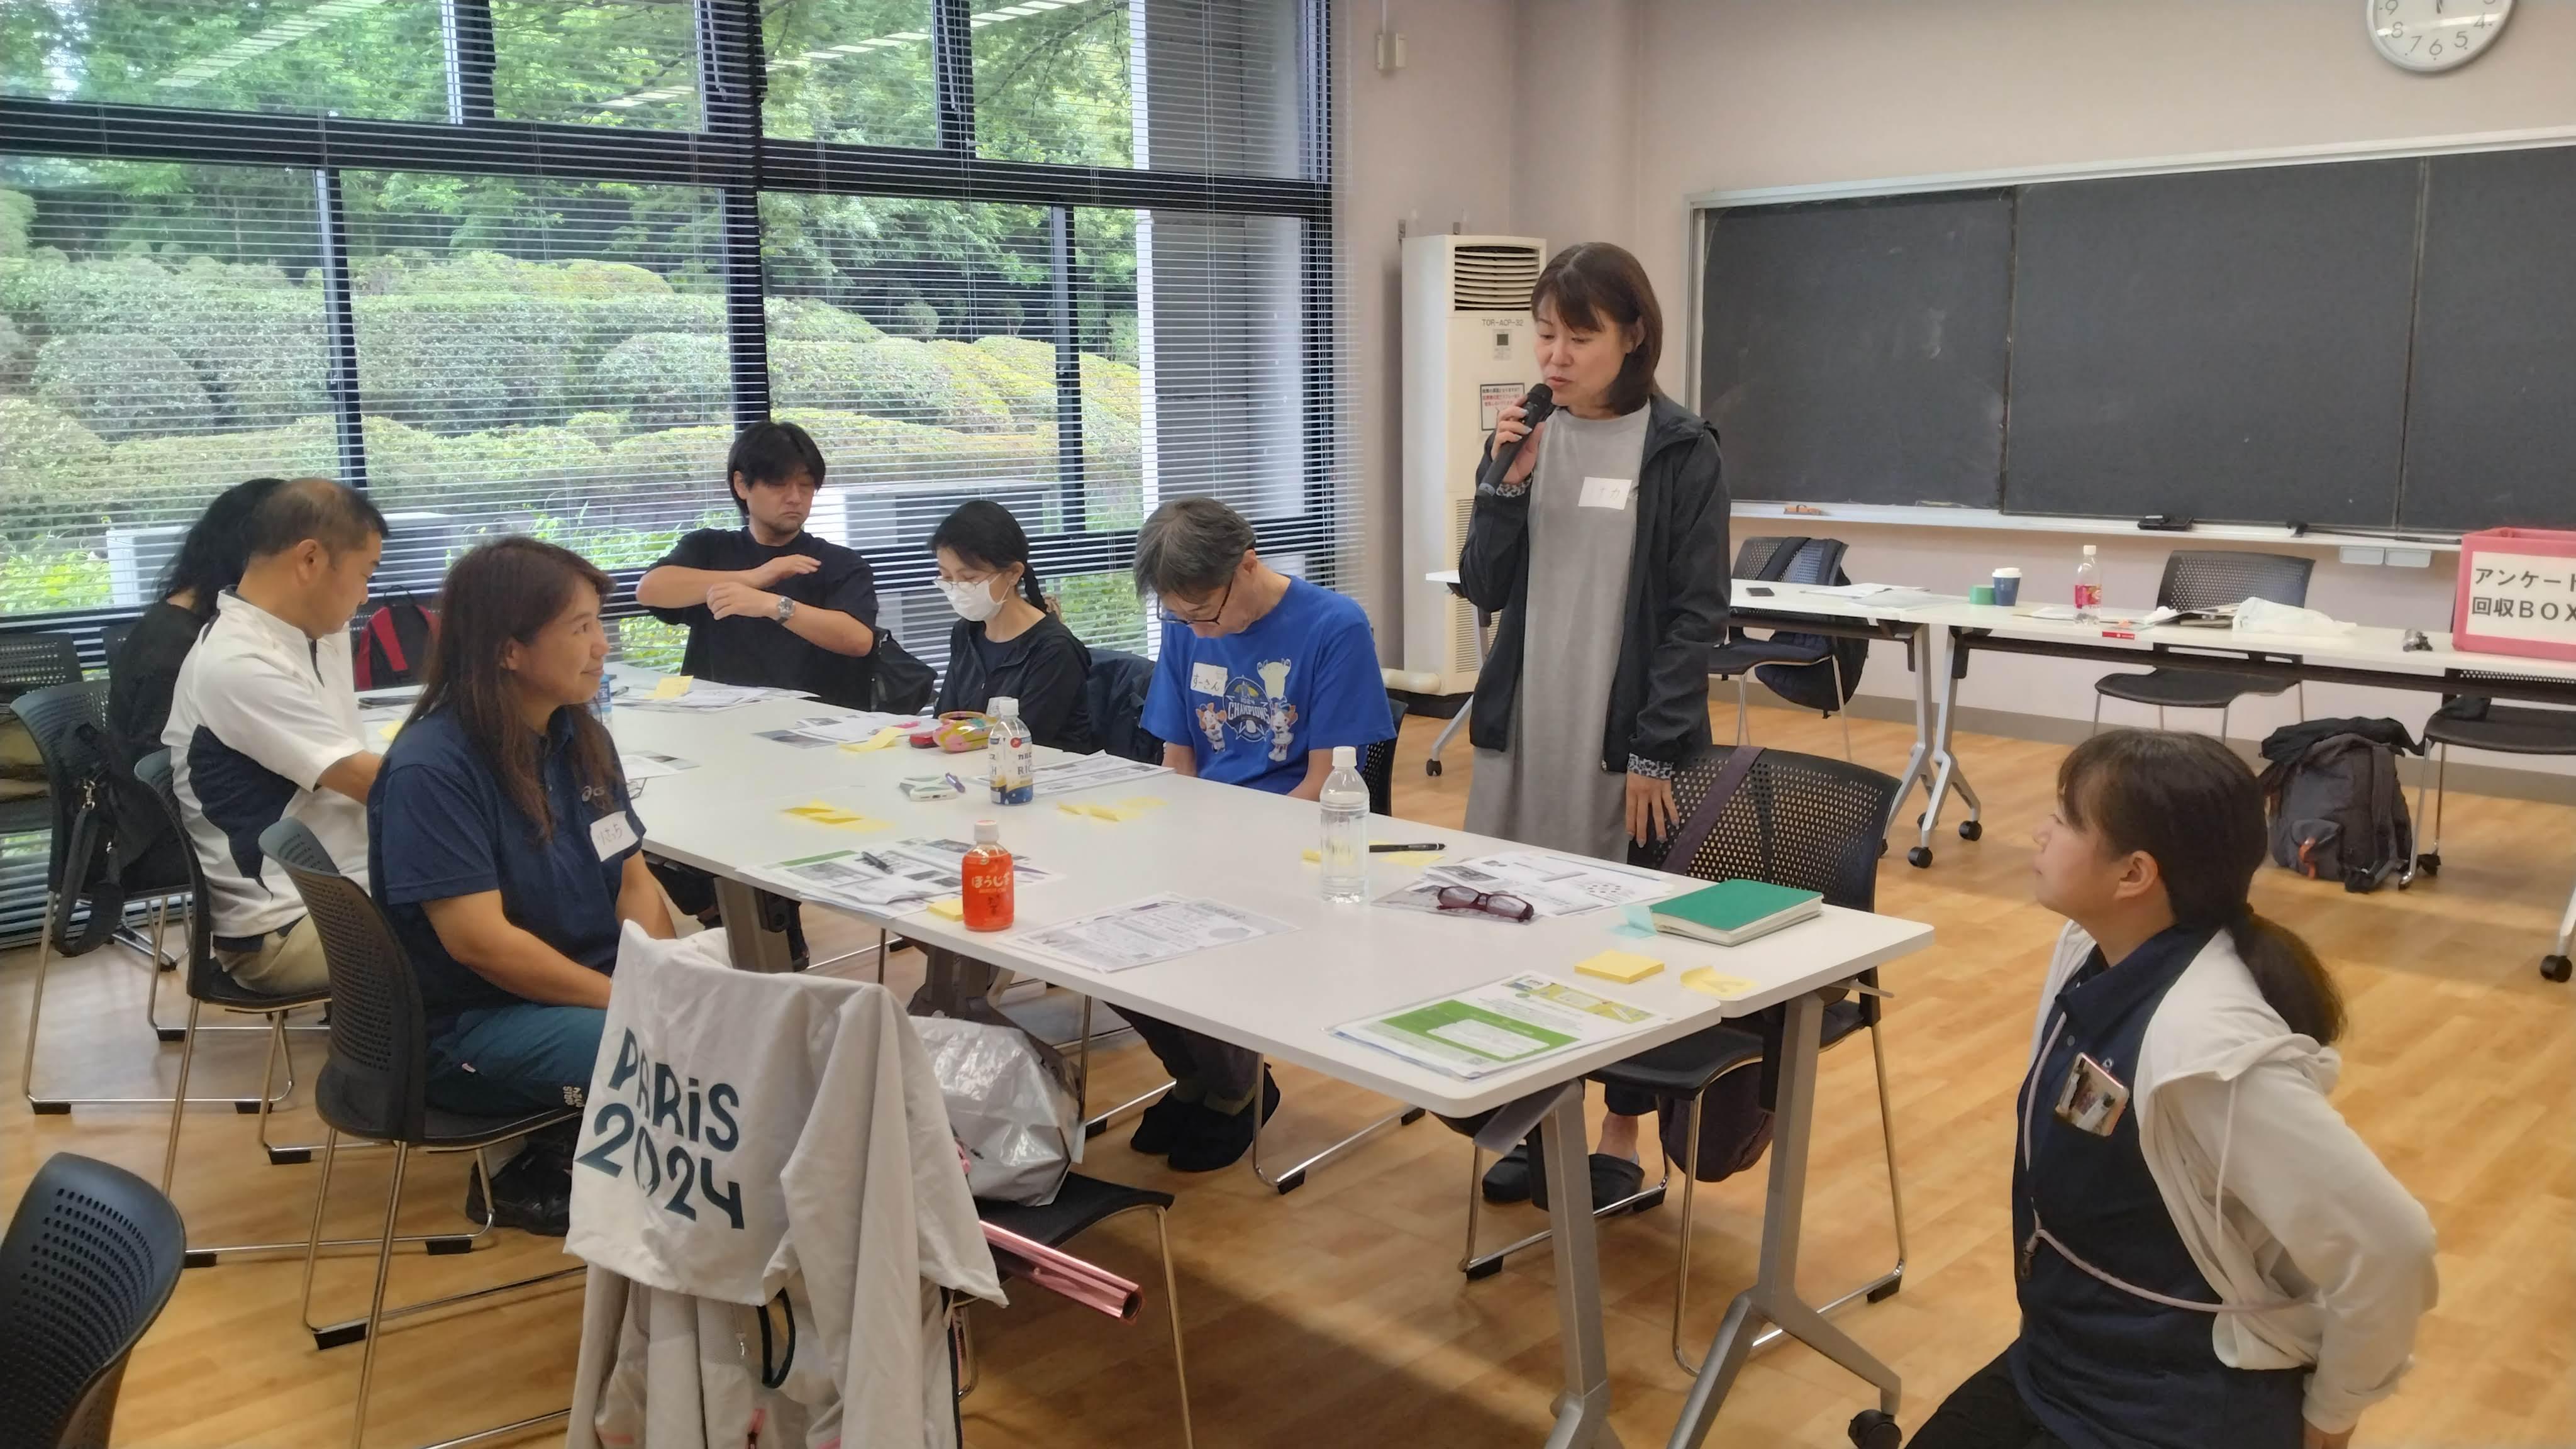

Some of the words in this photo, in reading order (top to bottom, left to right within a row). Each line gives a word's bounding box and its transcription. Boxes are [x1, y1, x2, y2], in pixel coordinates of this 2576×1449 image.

[2473, 13, 2485, 29] 4
[2390, 22, 2404, 38] 8
[2409, 35, 2423, 52] 7
[2429, 39, 2443, 55] 6
[2453, 31, 2468, 48] 5
[1228, 701, 1270, 724] CHAMPIONS
[575, 1102, 745, 1230] 2024
